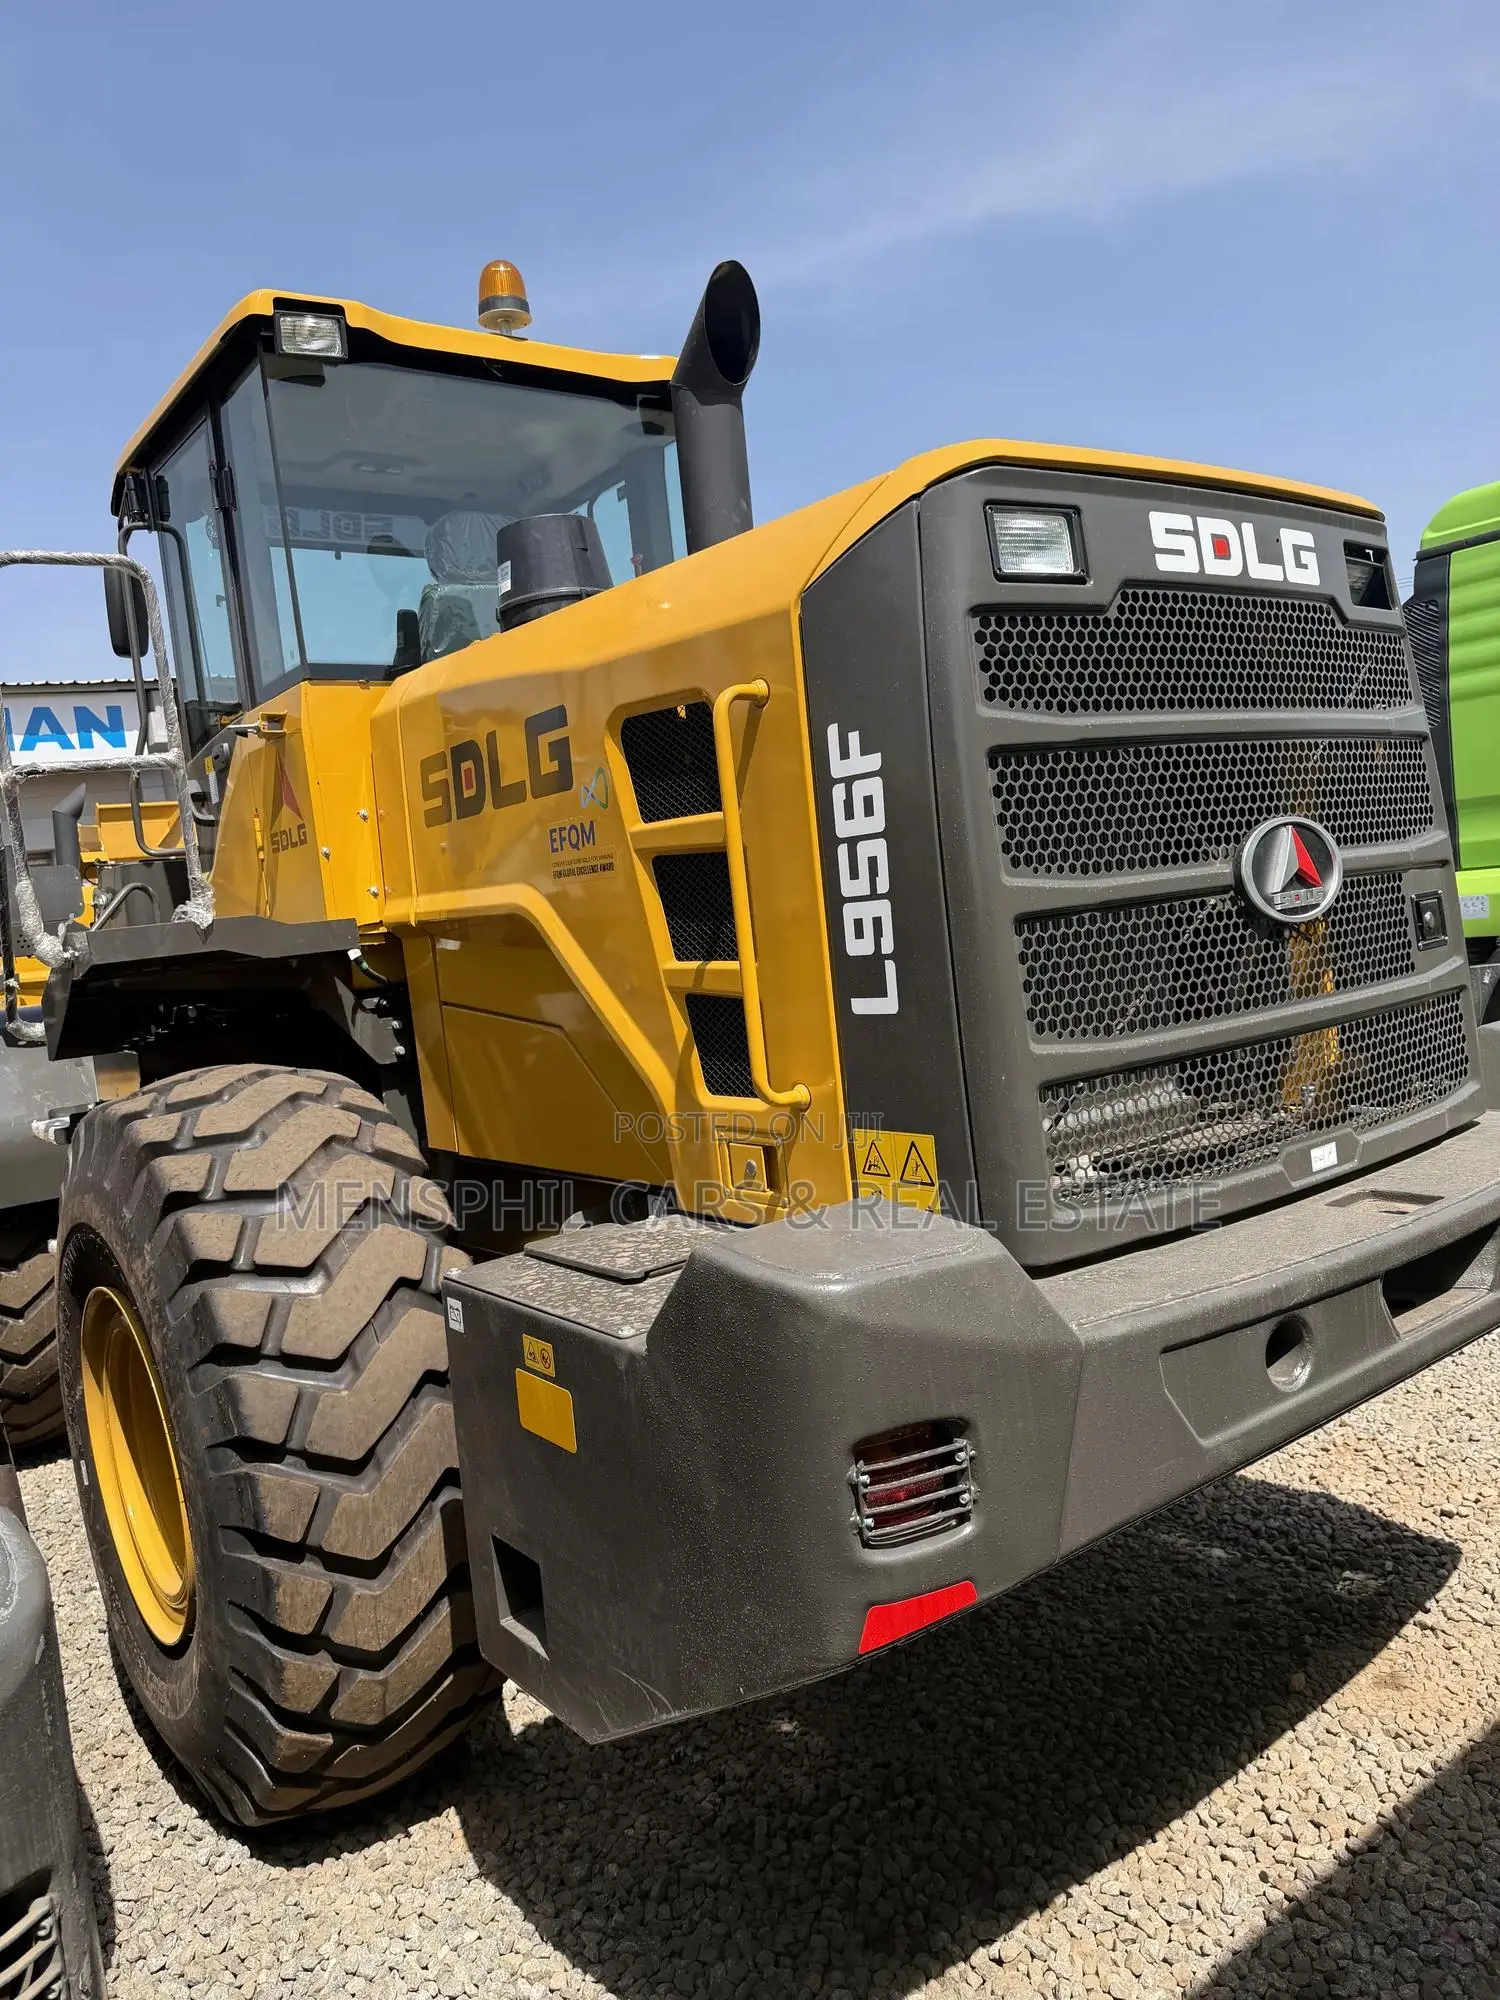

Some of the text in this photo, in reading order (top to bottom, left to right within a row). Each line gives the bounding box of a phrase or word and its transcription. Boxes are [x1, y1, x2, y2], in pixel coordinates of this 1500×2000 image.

[1149, 511, 1320, 586] SDLG
[3, 705, 127, 751] AN
[420, 704, 573, 828] SDLG
[270, 823, 307, 854] SDLG
[549, 820, 596, 853] EFQM
[827, 723, 899, 1015] L956F
